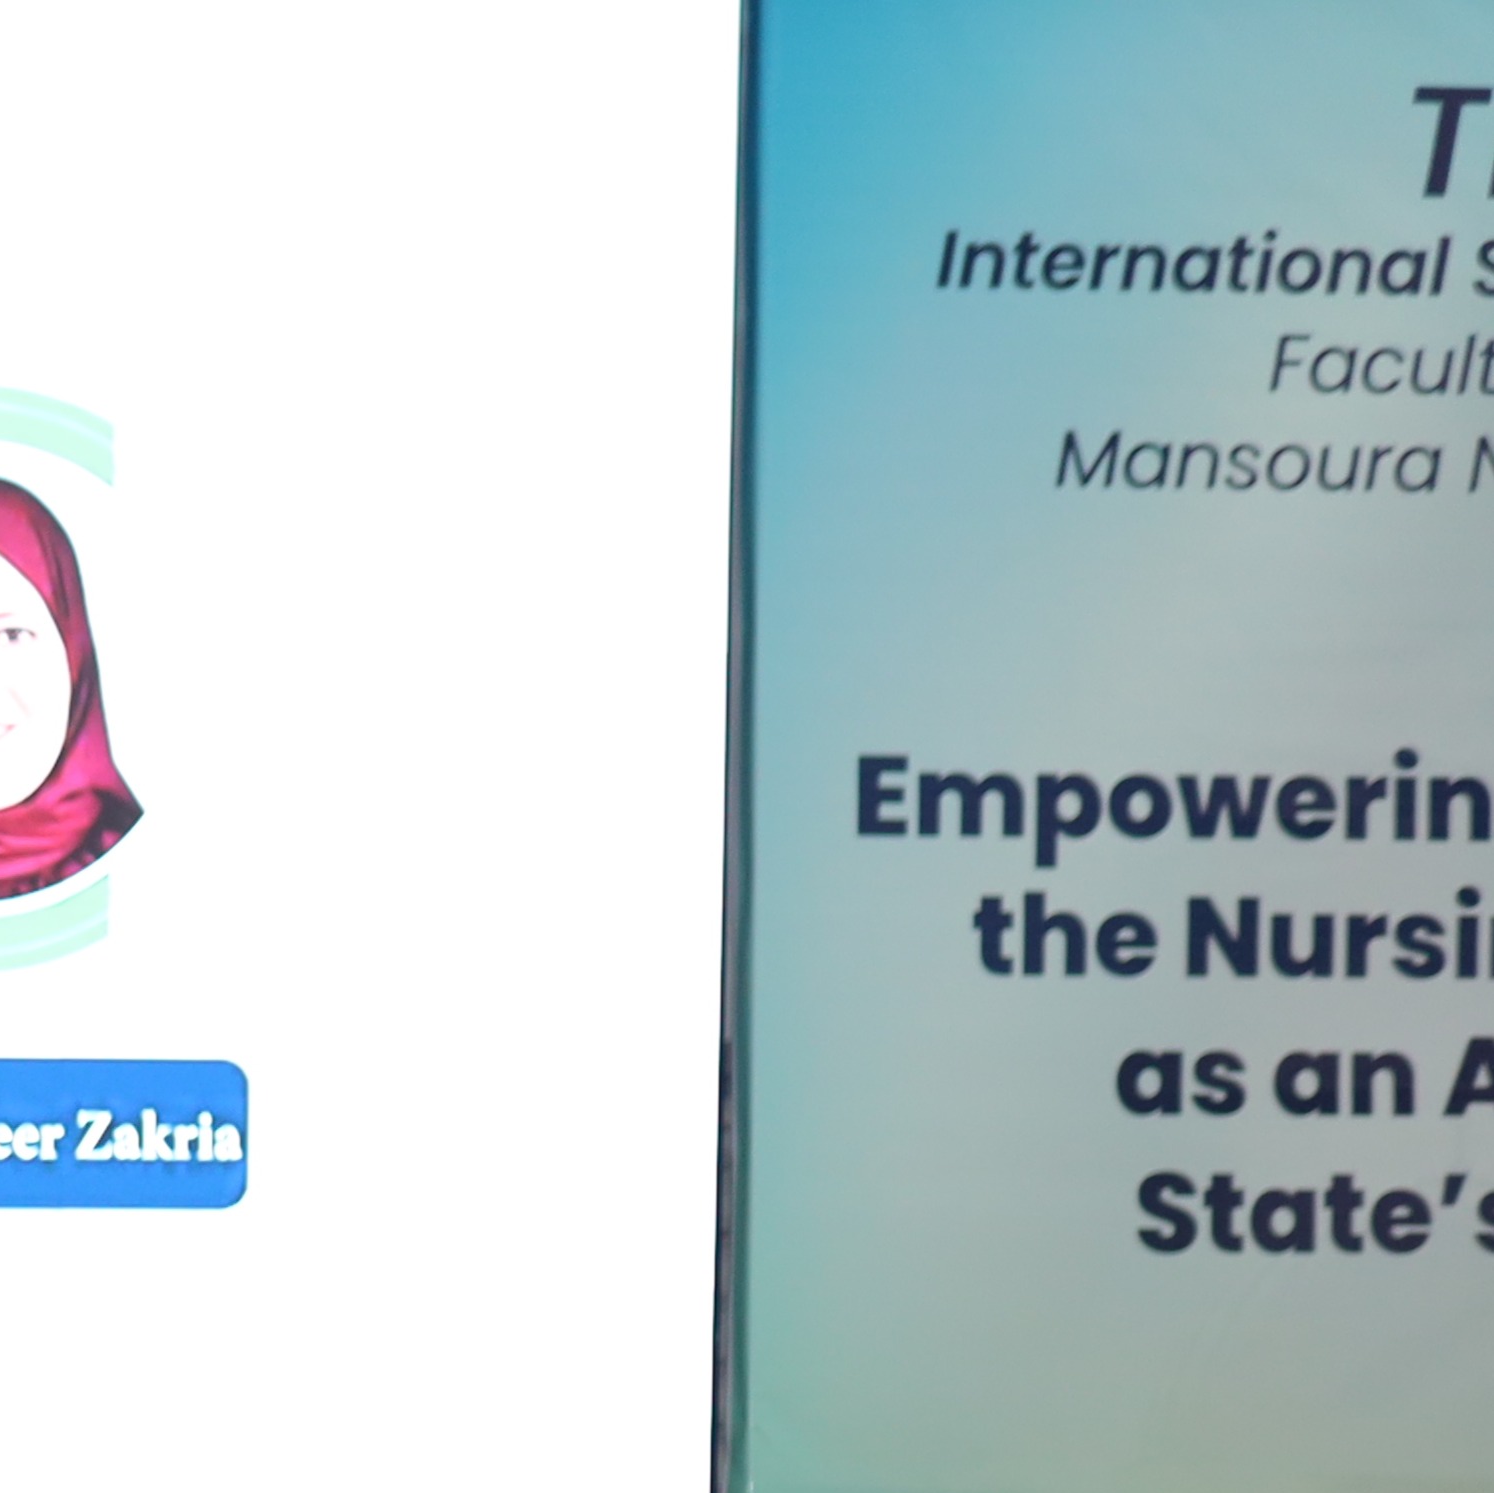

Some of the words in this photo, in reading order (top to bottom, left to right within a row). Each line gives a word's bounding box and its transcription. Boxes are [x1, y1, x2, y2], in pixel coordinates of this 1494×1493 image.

[937, 229, 1451, 297] International
[1270, 333, 1494, 396] Facult
[1055, 430, 1442, 494] Mansoura
[856, 746, 1494, 869] Empowerin
[972, 891, 1159, 978] the
[1185, 885, 1494, 980] Nursi
[1114, 1049, 1247, 1117] as
[1272, 1050, 1415, 1117] an
[75, 1109, 243, 1162] Zakria
